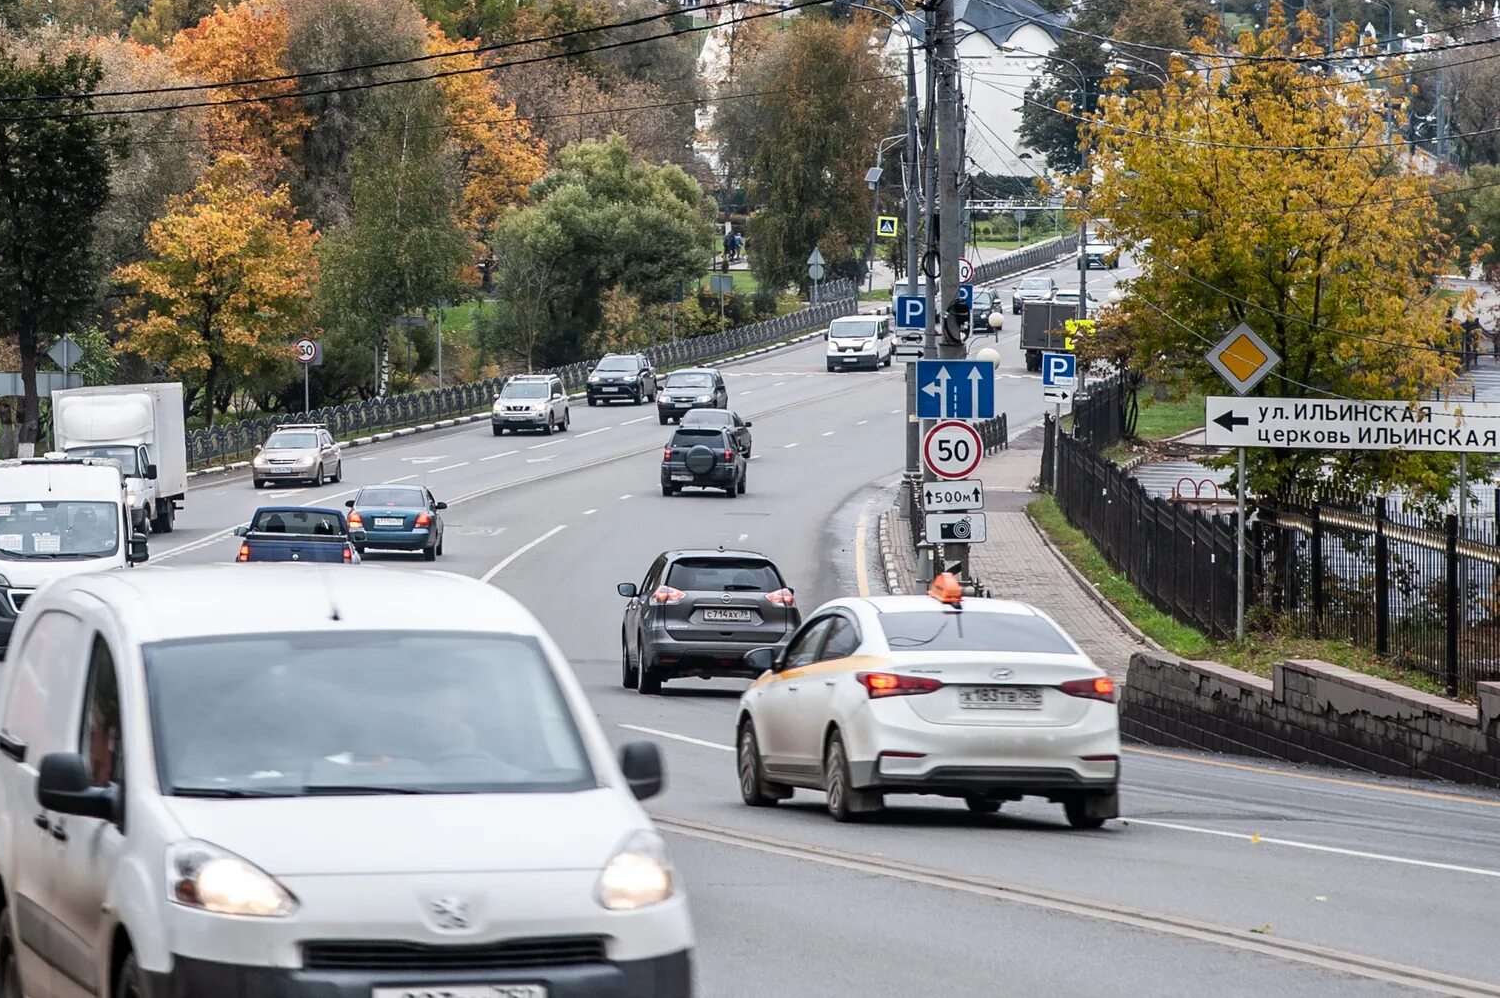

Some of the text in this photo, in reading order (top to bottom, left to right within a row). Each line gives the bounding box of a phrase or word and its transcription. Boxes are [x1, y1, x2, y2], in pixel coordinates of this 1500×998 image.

[905, 299, 924, 325] P
[1049, 357, 1068, 382] P
[1258, 404, 1432, 423] ул. ИЛЬИНСКАЯ
[1258, 427, 1497, 447] церковь ИЛЬИНСКАЯ
[938, 440, 970, 462] 50
